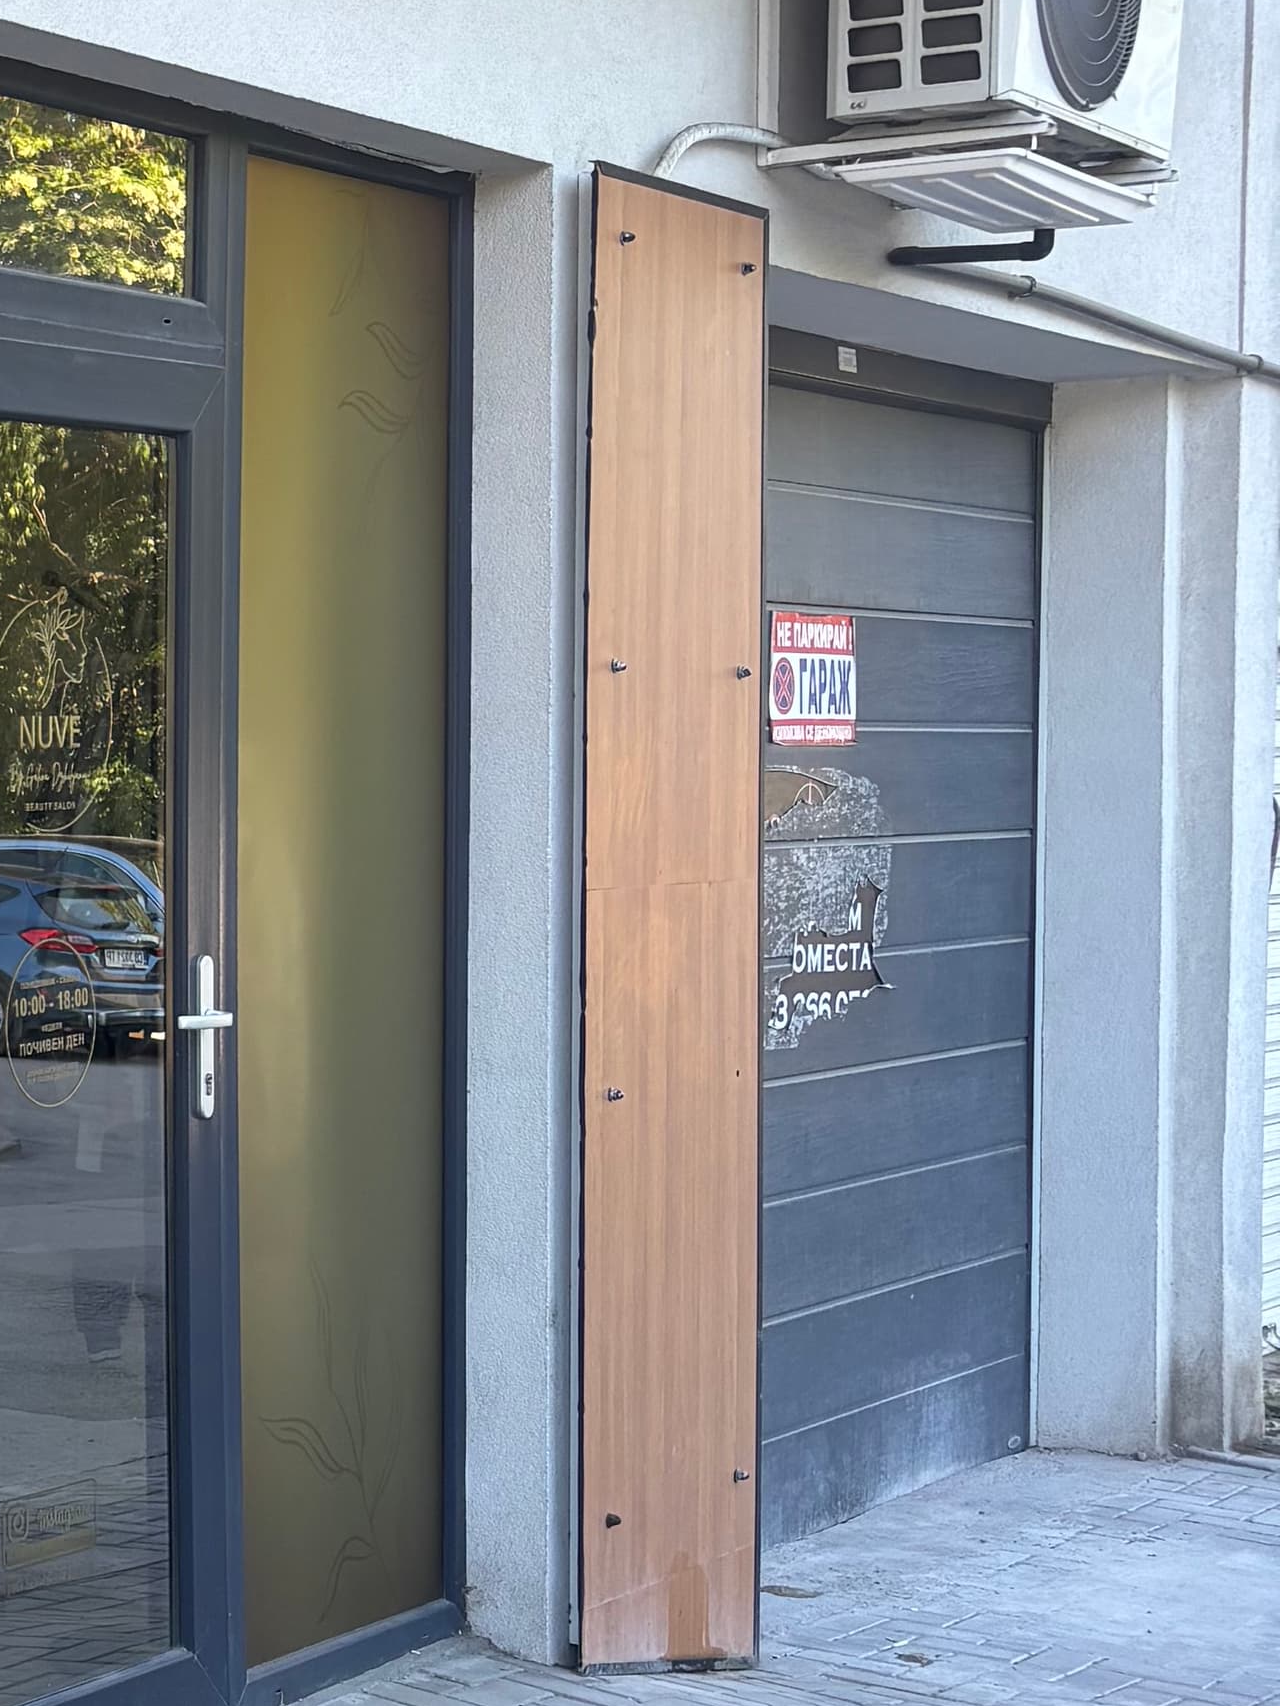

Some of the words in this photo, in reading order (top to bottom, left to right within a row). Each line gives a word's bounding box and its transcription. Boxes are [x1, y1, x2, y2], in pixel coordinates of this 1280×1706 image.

[777, 621, 792, 647] НЕ
[799, 657, 852, 716] ГАРАЖ
[13, 994, 46, 1018] 10:00
[57, 987, 88, 1011] 18:00
[20, 1036, 64, 1057] ПОЧИВЕН
[65, 1033, 85, 1051] ДЕН
